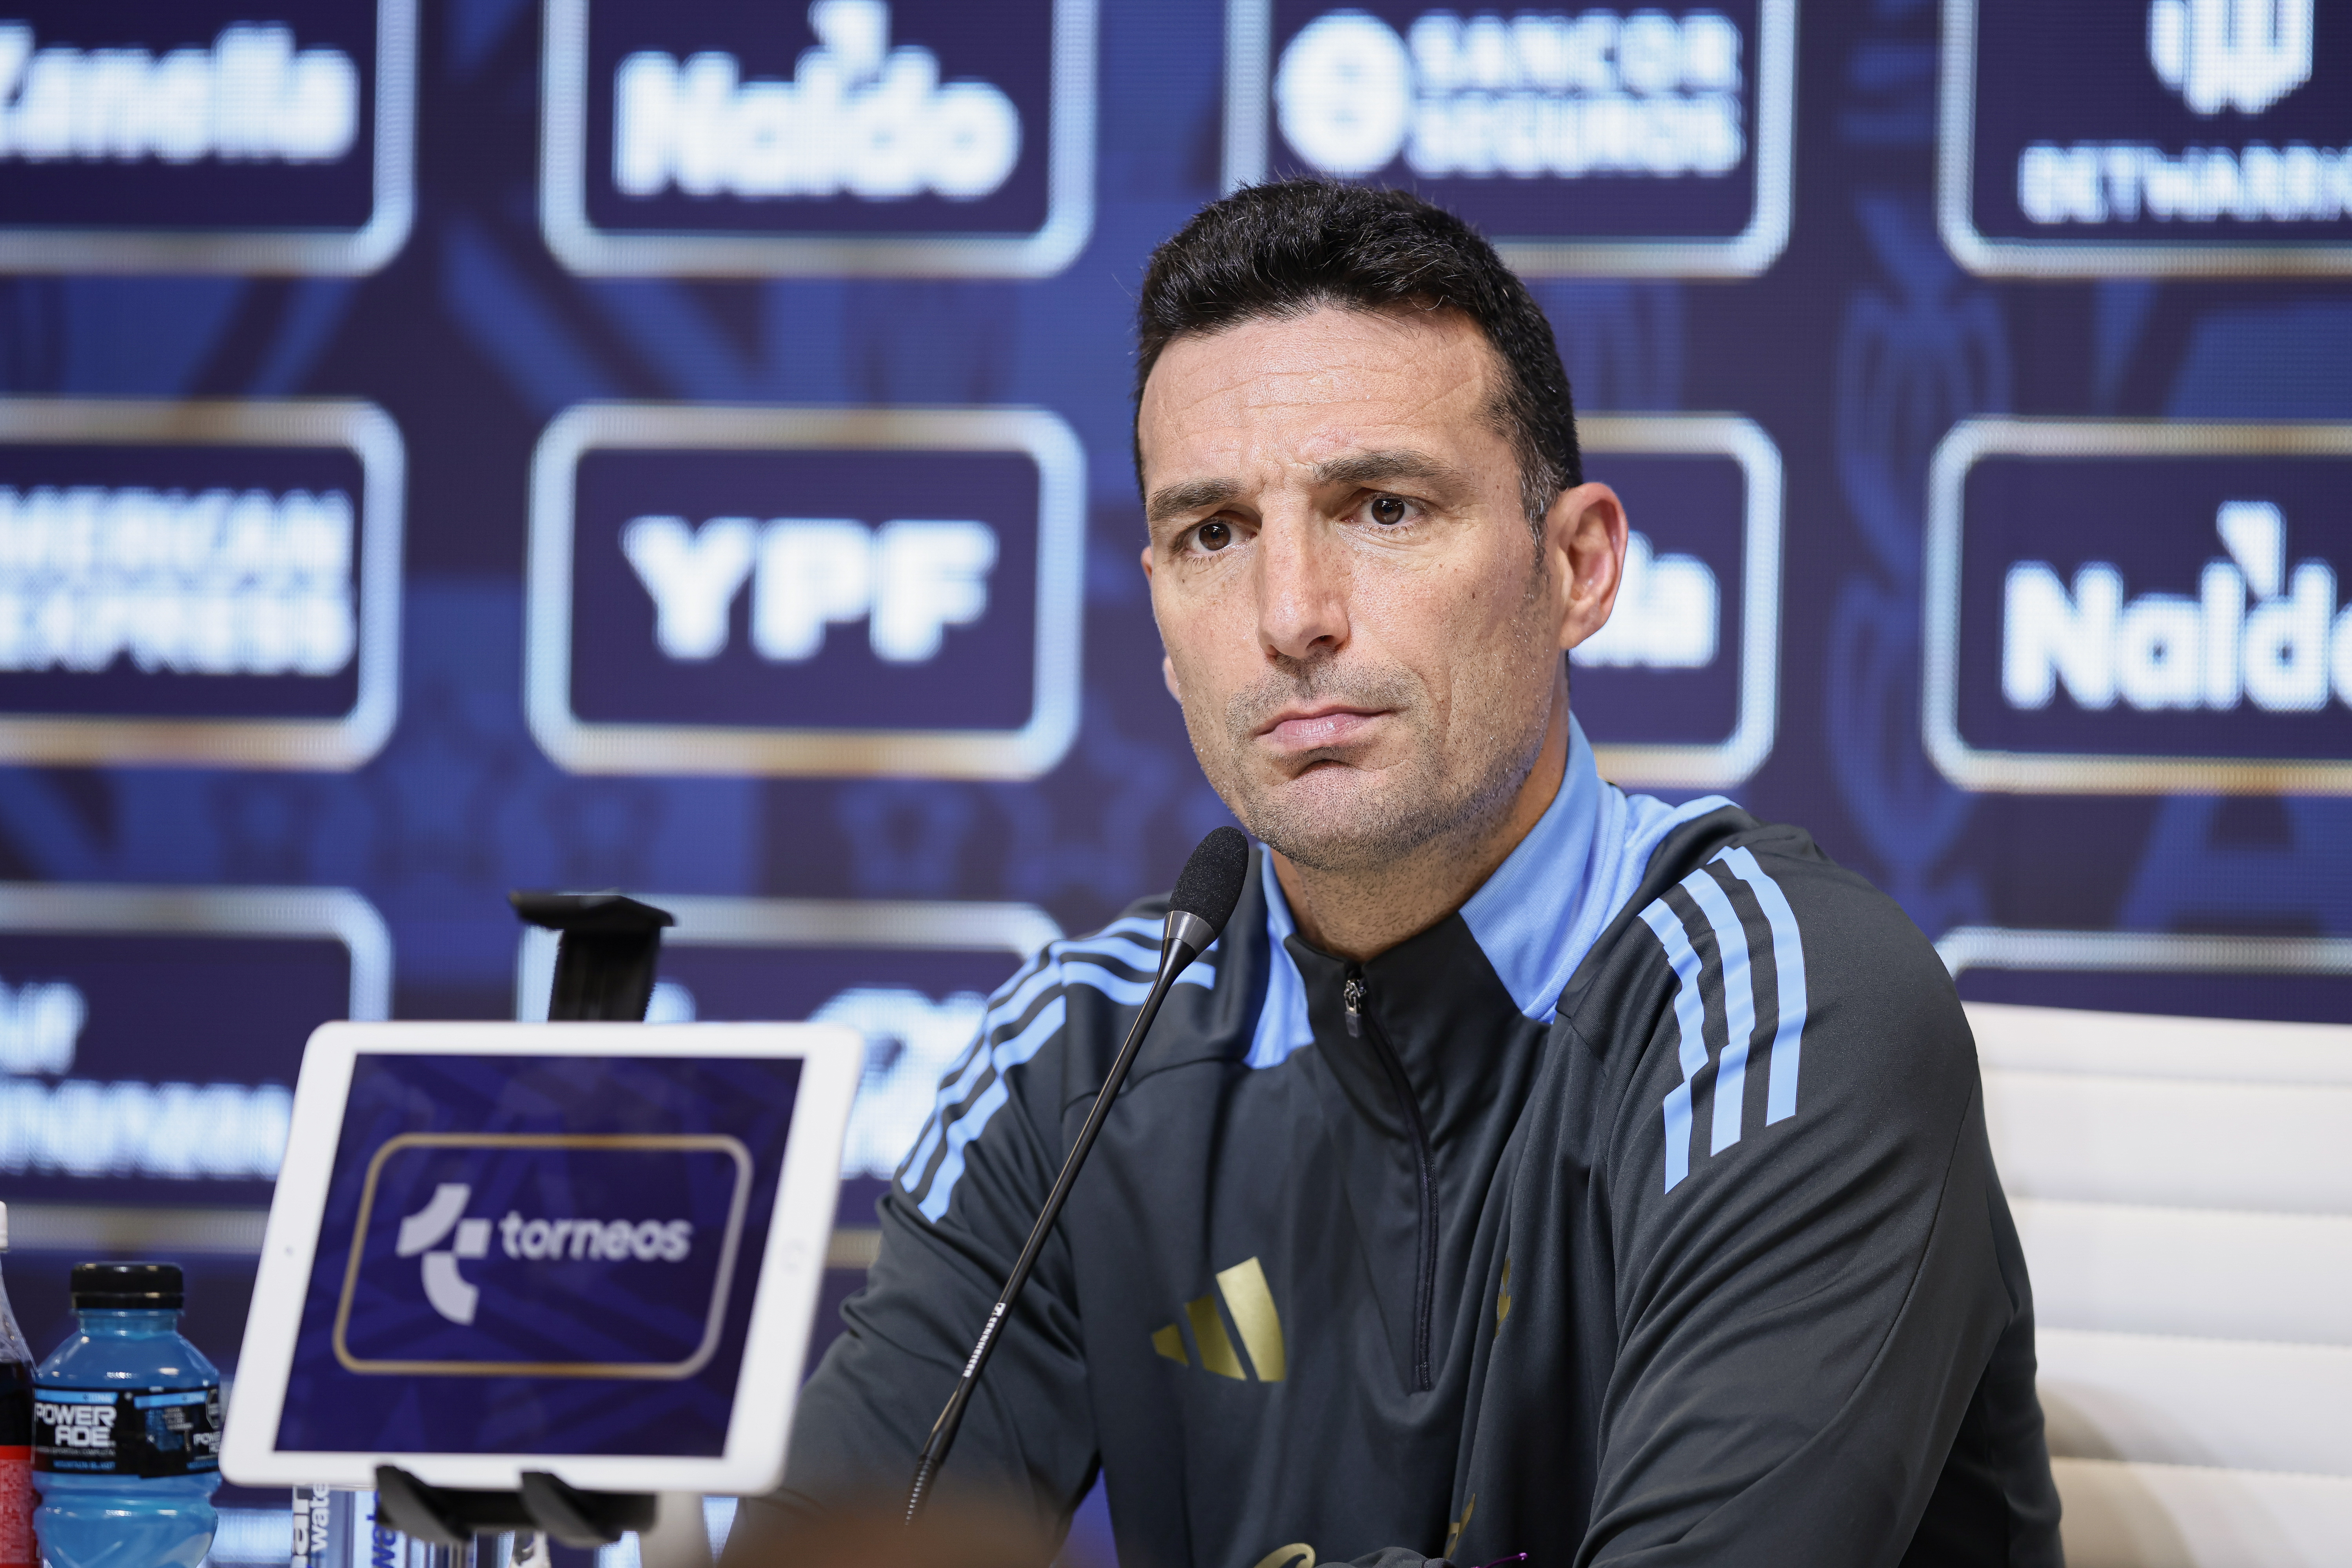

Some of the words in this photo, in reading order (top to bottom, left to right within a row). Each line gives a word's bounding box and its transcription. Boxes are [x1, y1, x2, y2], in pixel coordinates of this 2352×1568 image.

[622, 516, 998, 664] YPF
[2001, 561, 2352, 712] Nald
[499, 1211, 693, 1261] torneos
[34, 1402, 117, 1428] POWER
